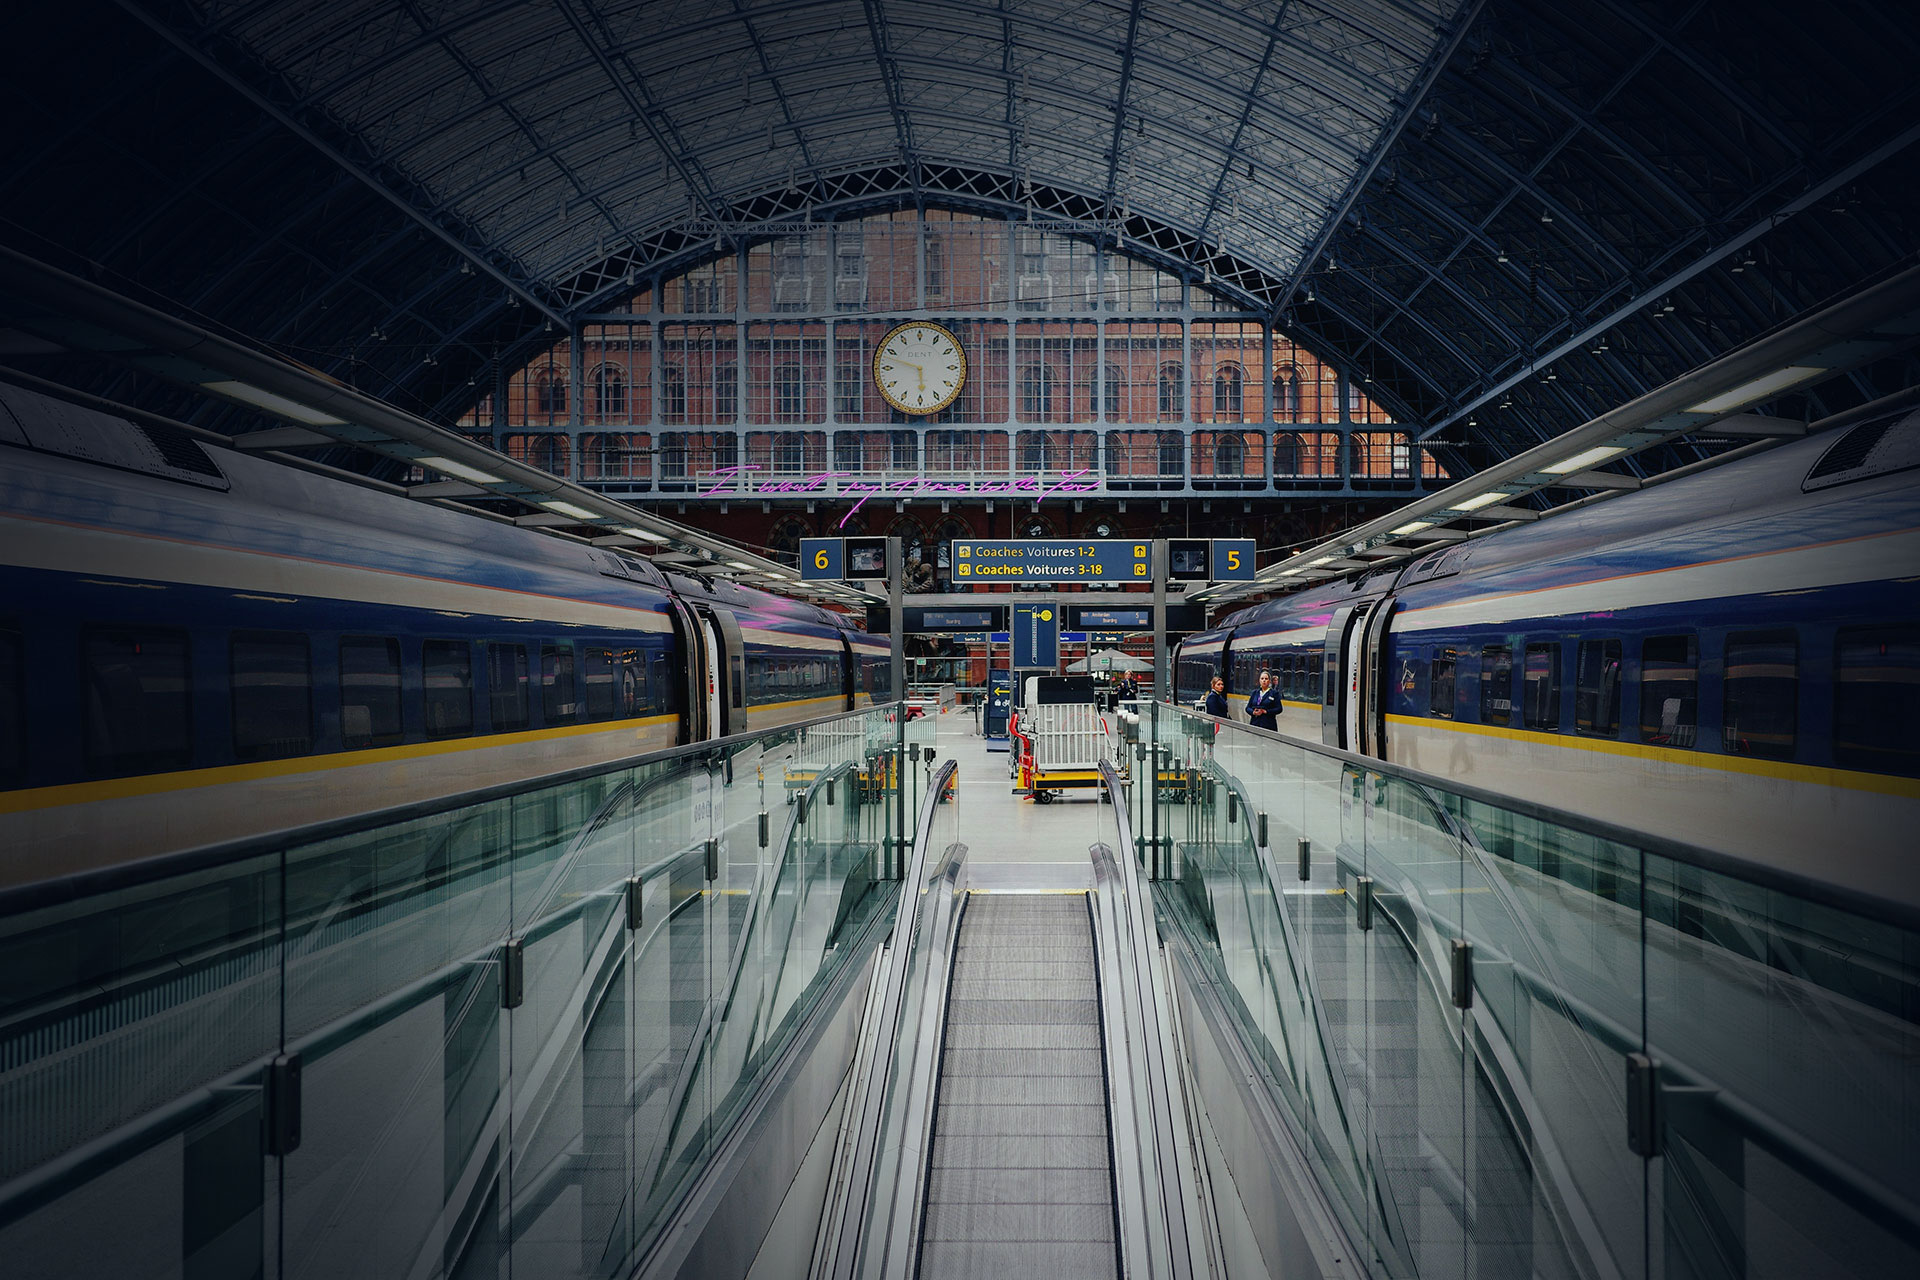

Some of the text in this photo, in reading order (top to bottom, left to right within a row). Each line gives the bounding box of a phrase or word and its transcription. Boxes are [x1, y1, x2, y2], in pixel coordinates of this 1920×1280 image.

[814, 549, 829, 570] 6
[975, 546, 1096, 558] Coaches Voitures 1-2
[1227, 550, 1240, 571] 5
[975, 564, 1103, 576] Coaches Voitures 3-18
